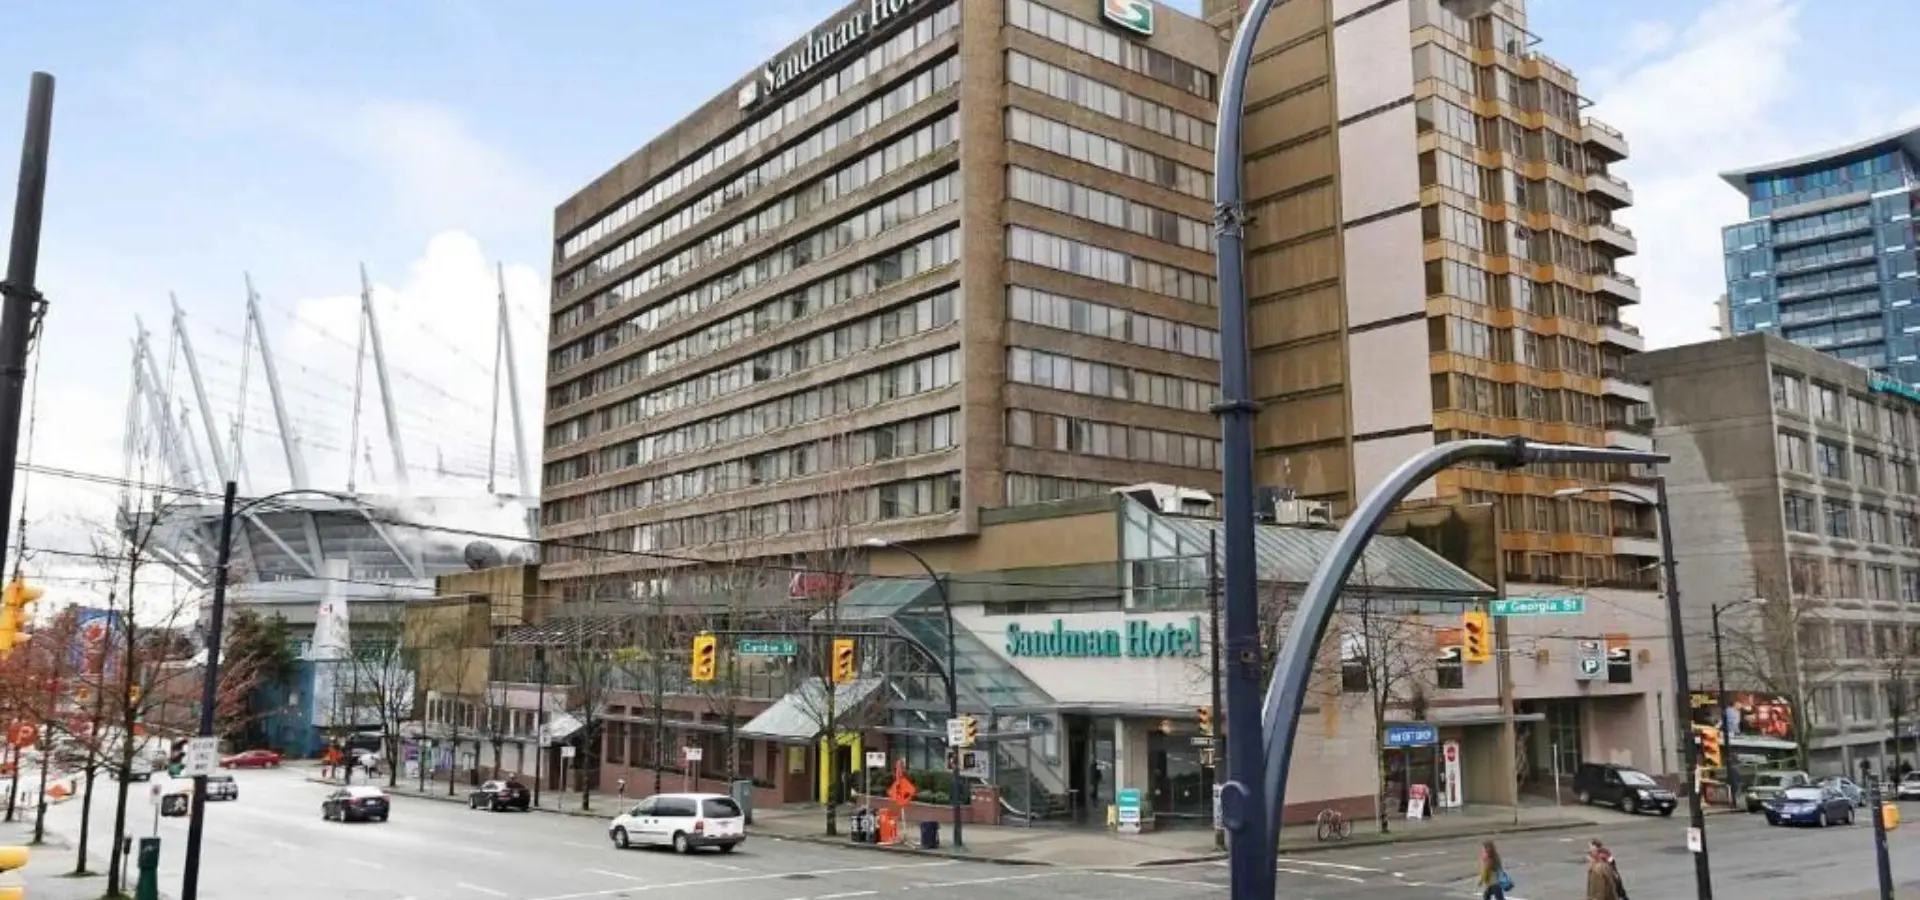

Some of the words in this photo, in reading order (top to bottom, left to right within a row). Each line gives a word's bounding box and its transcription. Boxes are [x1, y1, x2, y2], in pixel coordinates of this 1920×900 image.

[764, 10, 868, 95] Sandman
[1496, 600, 1506, 612] W
[1511, 600, 1557, 614] Georgia
[1563, 599, 1576, 611] St
[1006, 618, 1121, 657] Sandman
[1125, 615, 1201, 657] Hotel
